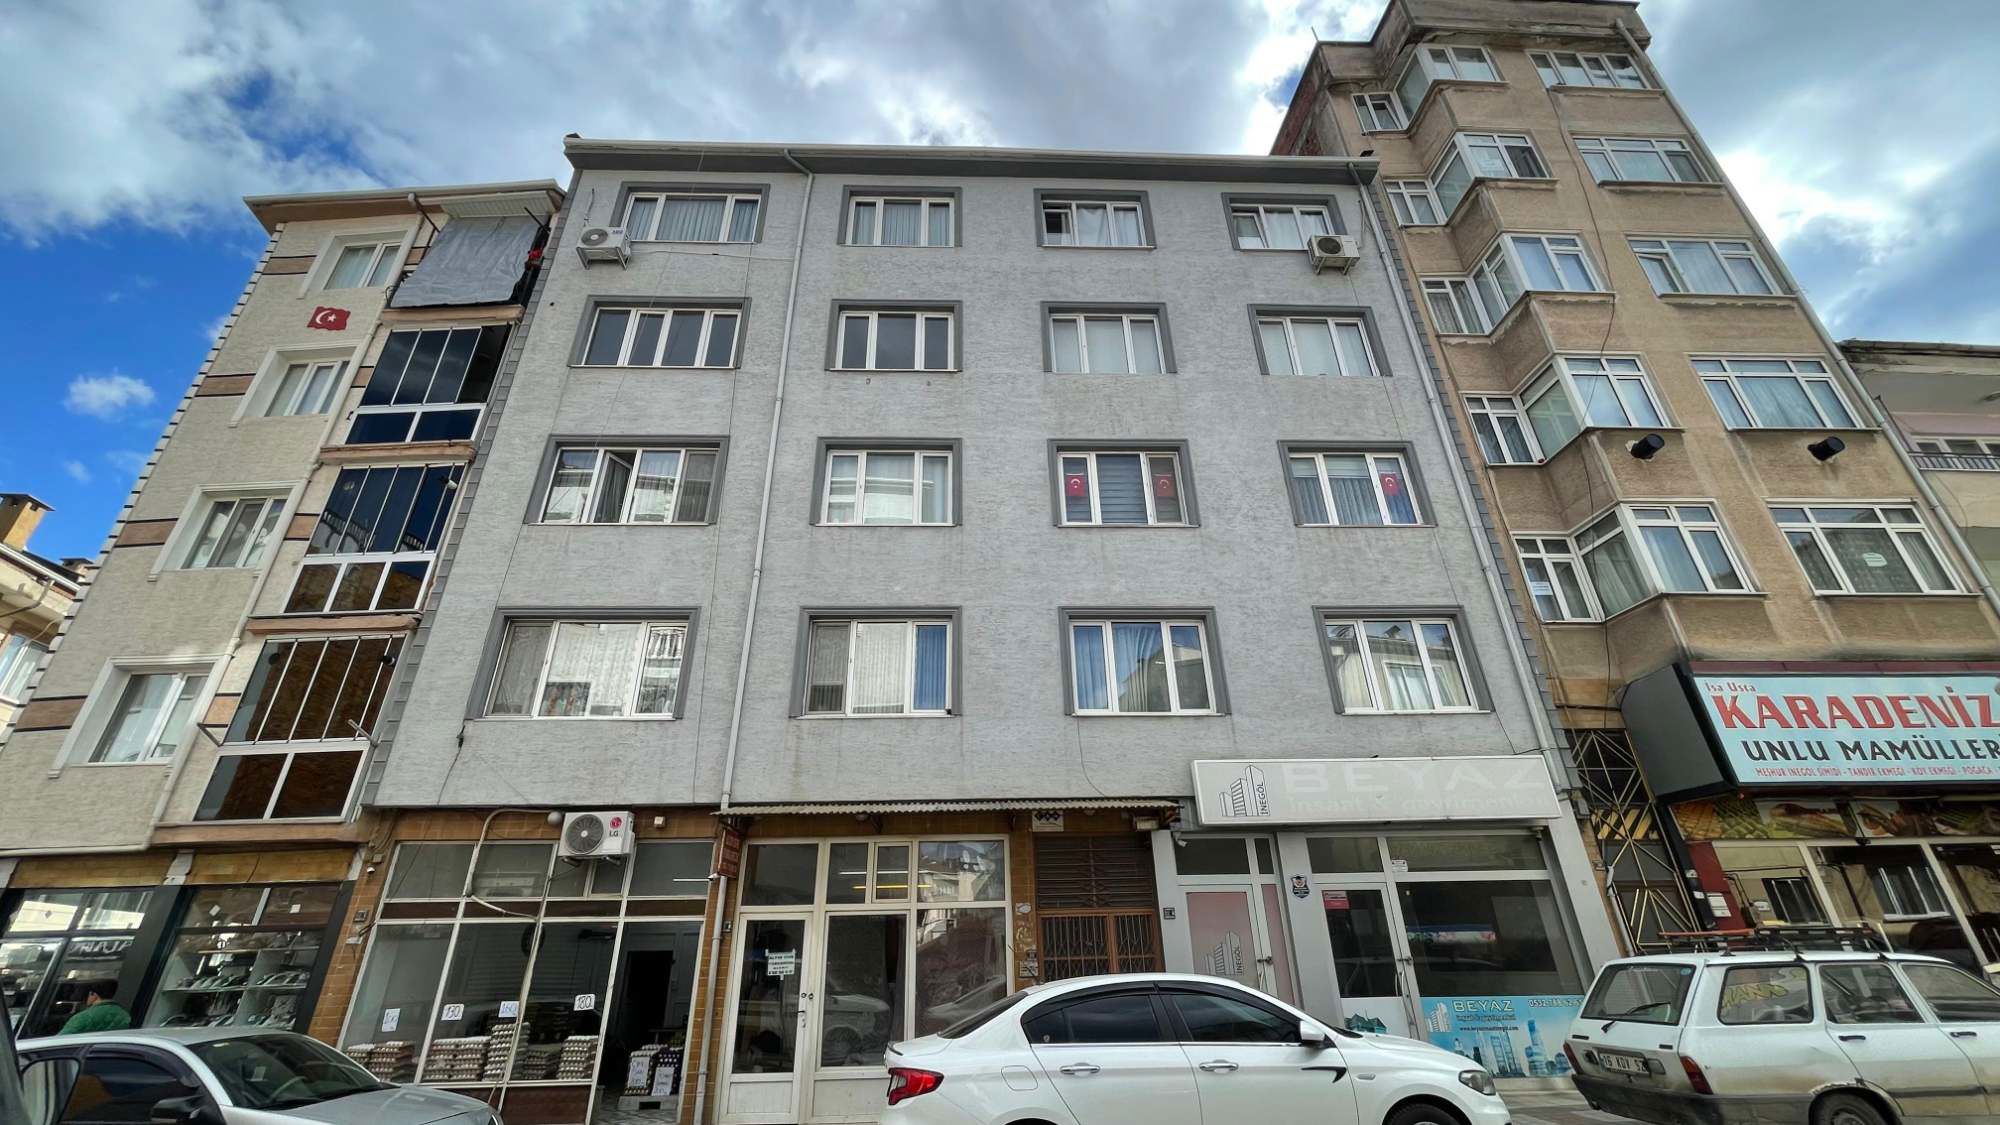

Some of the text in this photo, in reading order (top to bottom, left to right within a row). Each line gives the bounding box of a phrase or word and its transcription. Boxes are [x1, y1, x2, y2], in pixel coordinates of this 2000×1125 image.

[1711, 685, 2000, 729] KARADENİZ
[1741, 734, 2000, 761] UNLU MAMÜLLER
[1281, 760, 1546, 792] BEYAZ
[1453, 1000, 1513, 1012] BEYAZ
